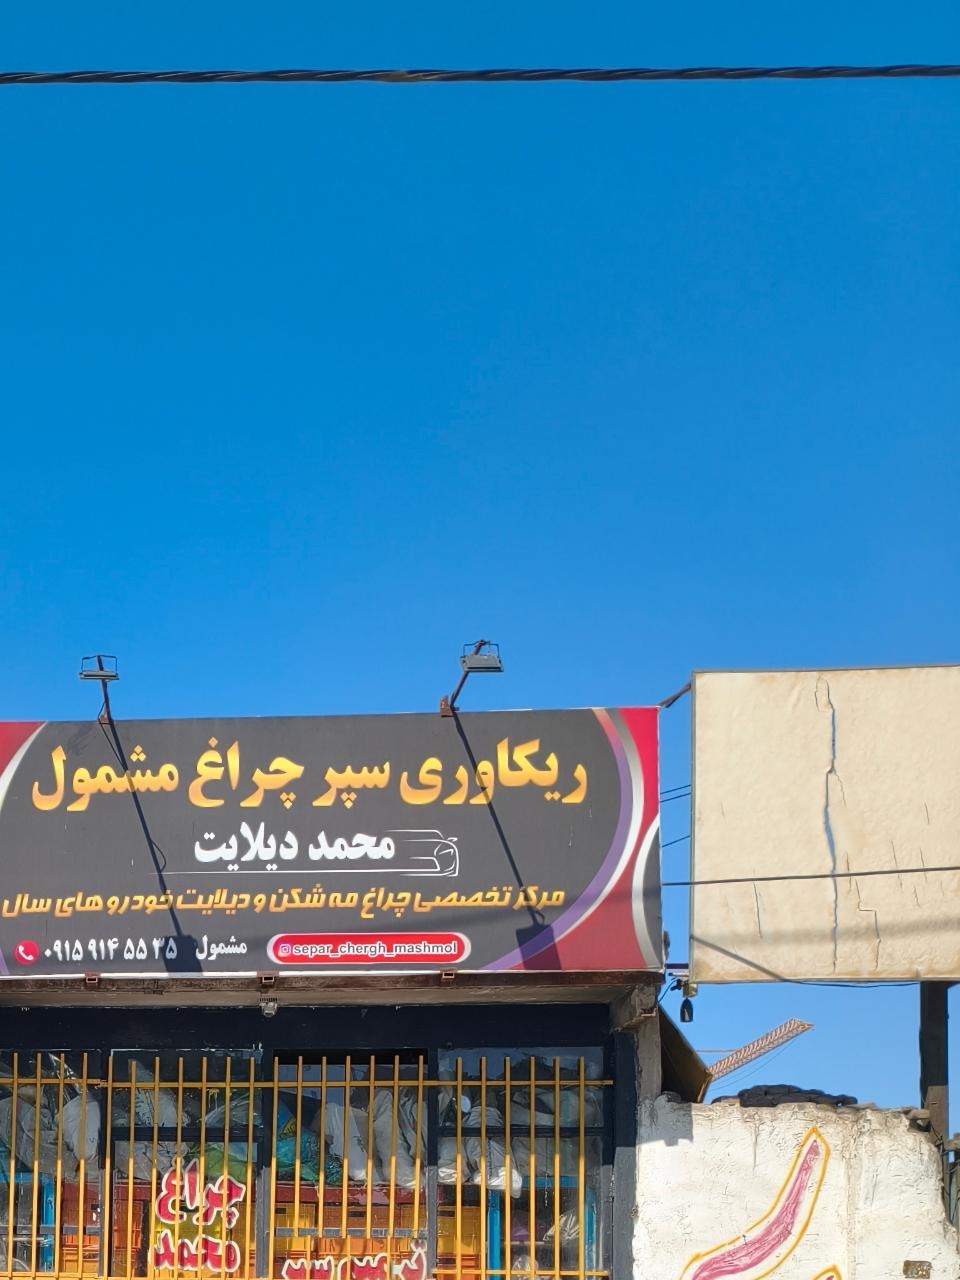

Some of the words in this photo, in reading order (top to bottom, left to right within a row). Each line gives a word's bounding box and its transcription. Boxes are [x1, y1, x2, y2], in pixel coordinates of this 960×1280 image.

[32, 744, 180, 812] مشمول
[188, 736, 305, 809] چراغ
[312, 761, 390, 809] سپر
[399, 737, 588, 805] ریکاوری
[194, 821, 299, 871] دیلایت
[308, 830, 395, 861] محمد
[1, 893, 53, 918] سال
[176, 888, 252, 915] دیلایت
[253, 892, 267, 914] و
[269, 883, 327, 913] شکن
[360, 887, 412, 919] چراغ
[413, 886, 512, 913] تخصصی
[512, 886, 566, 911] مرکز
[195, 935, 248, 961] مشمول
[293, 941, 458, 957] separ_chergh_mashmol
[156, 1154, 246, 1228] چراغ
[148, 1230, 240, 1272] محمد
